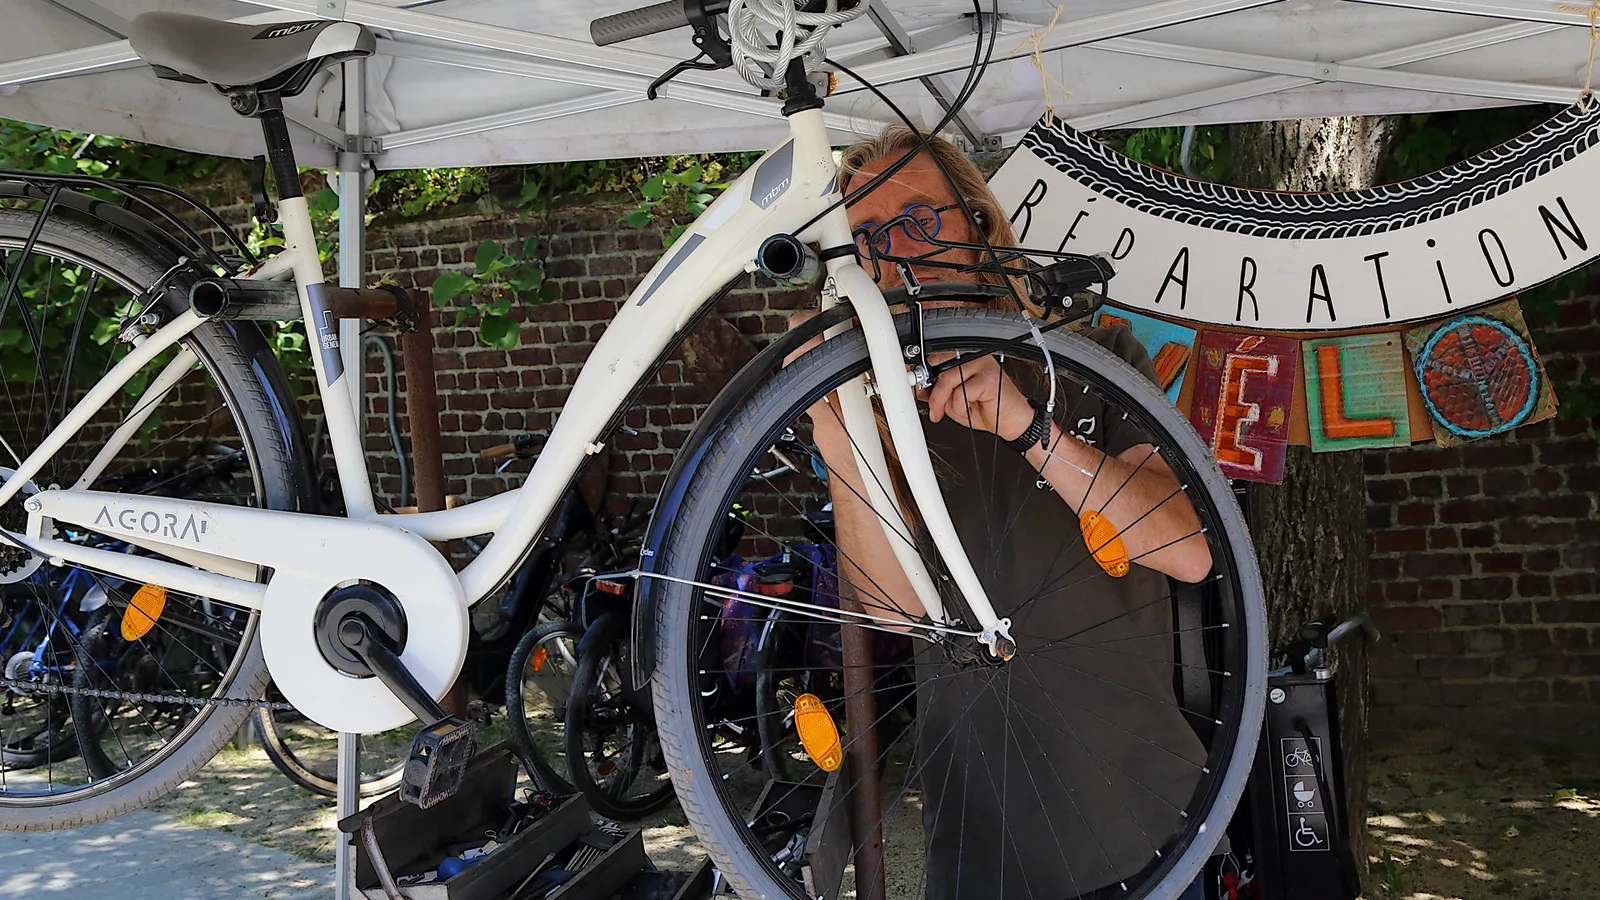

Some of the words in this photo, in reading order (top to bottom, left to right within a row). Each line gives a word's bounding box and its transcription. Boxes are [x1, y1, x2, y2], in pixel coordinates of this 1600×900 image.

[268, 21, 320, 38] mbm
[761, 177, 789, 207] mbm
[94, 505, 200, 542] AGORA
